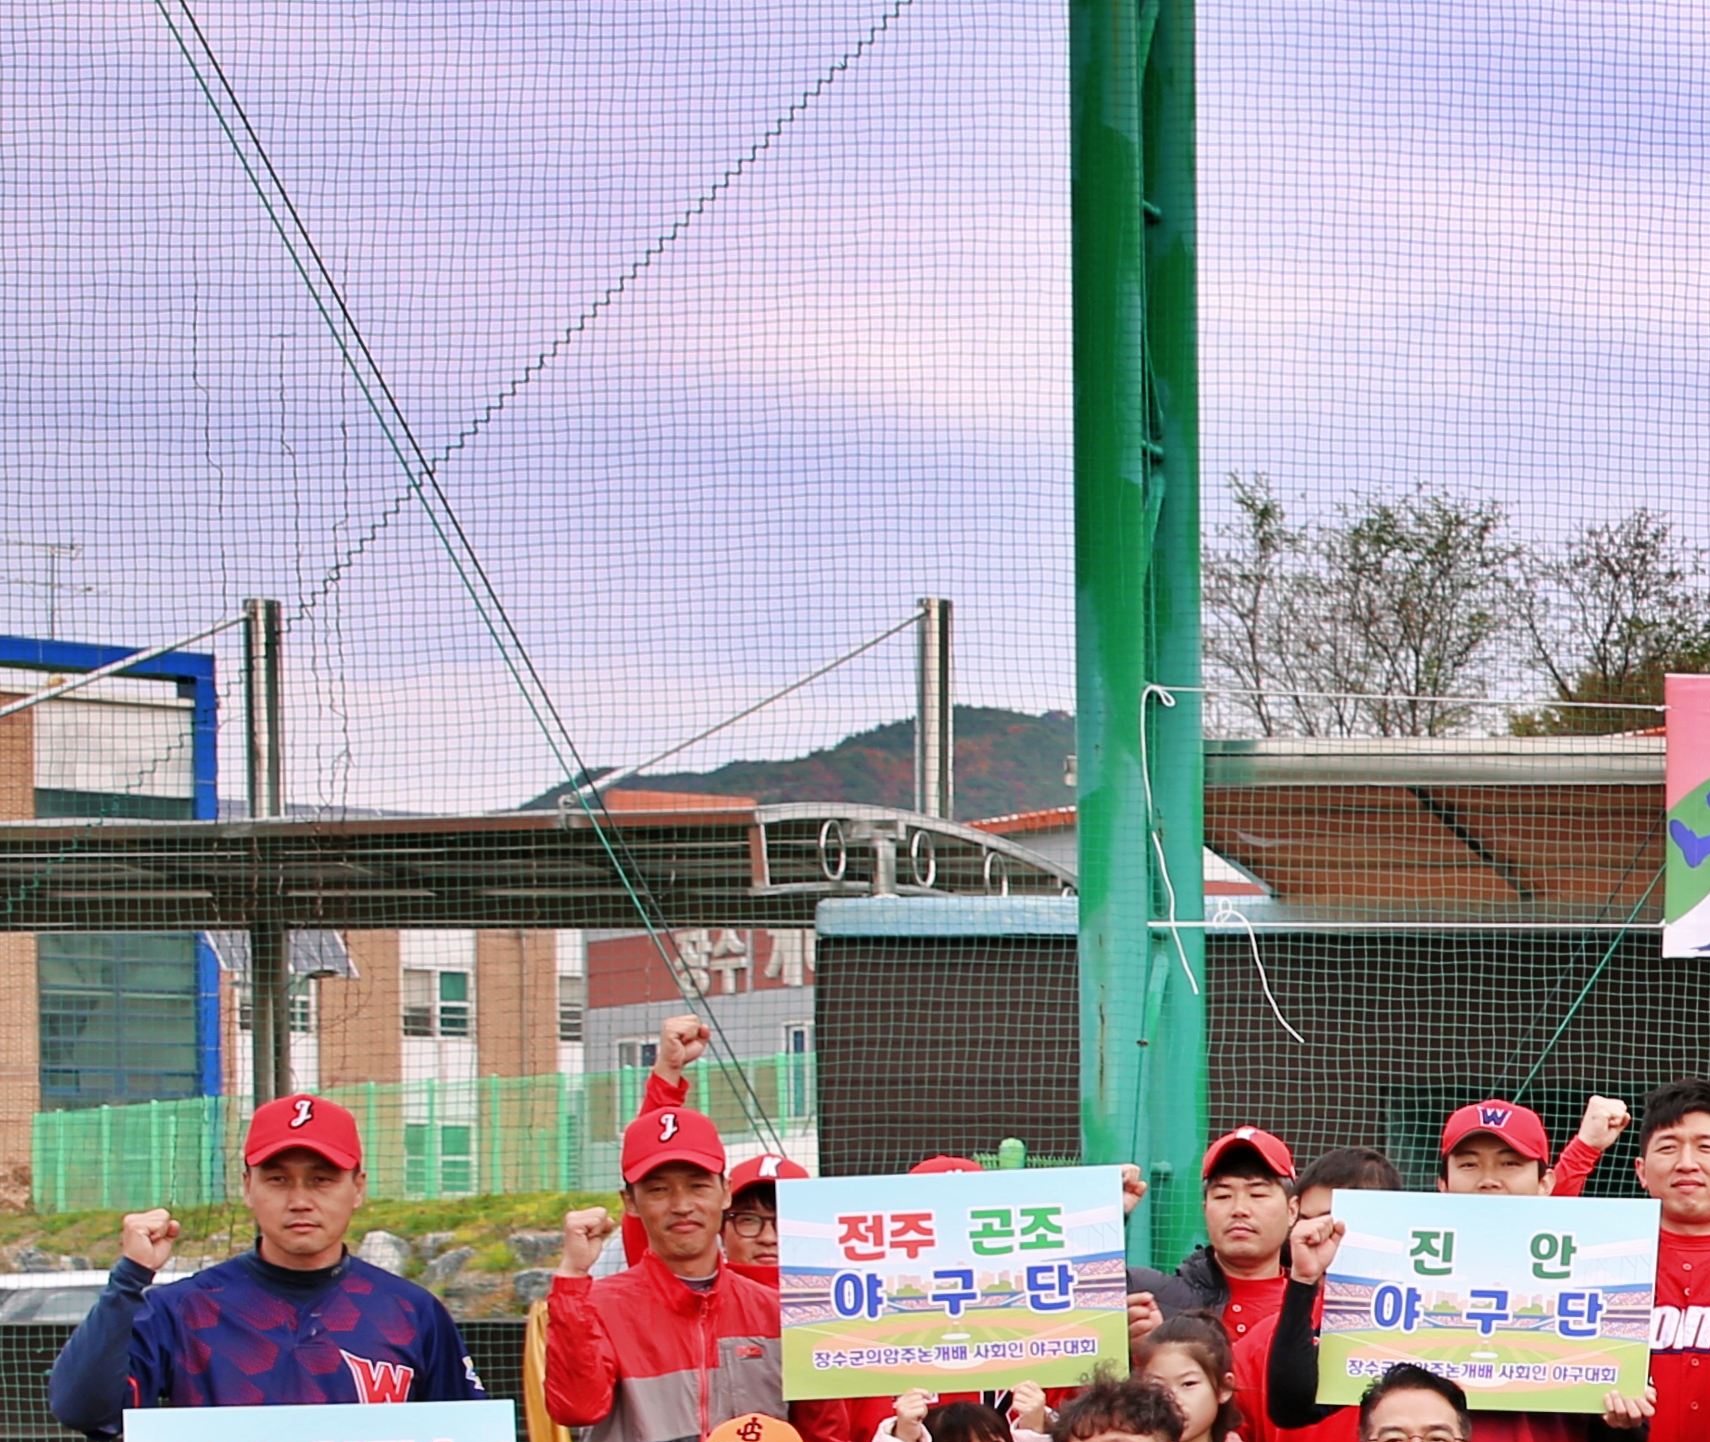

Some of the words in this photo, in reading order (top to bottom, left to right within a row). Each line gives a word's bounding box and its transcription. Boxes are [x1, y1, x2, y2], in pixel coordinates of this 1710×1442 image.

[290, 1099, 314, 1129] J
[659, 1113, 678, 1142] J
[1477, 1106, 1512, 1128] W
[759, 1155, 783, 1177] K
[837, 1212, 936, 1262] 전주
[968, 1206, 1065, 1256] 곤조
[813, 1345, 968, 1369] 장수군의암주논개배
[972, 1342, 1024, 1359] 사회인
[1028, 1338, 1097, 1357] 야구대회
[339, 1349, 414, 1404] W
[1497, 1363, 1547, 1381] 사회인
[1552, 1365, 1617, 1383] 야구대회
